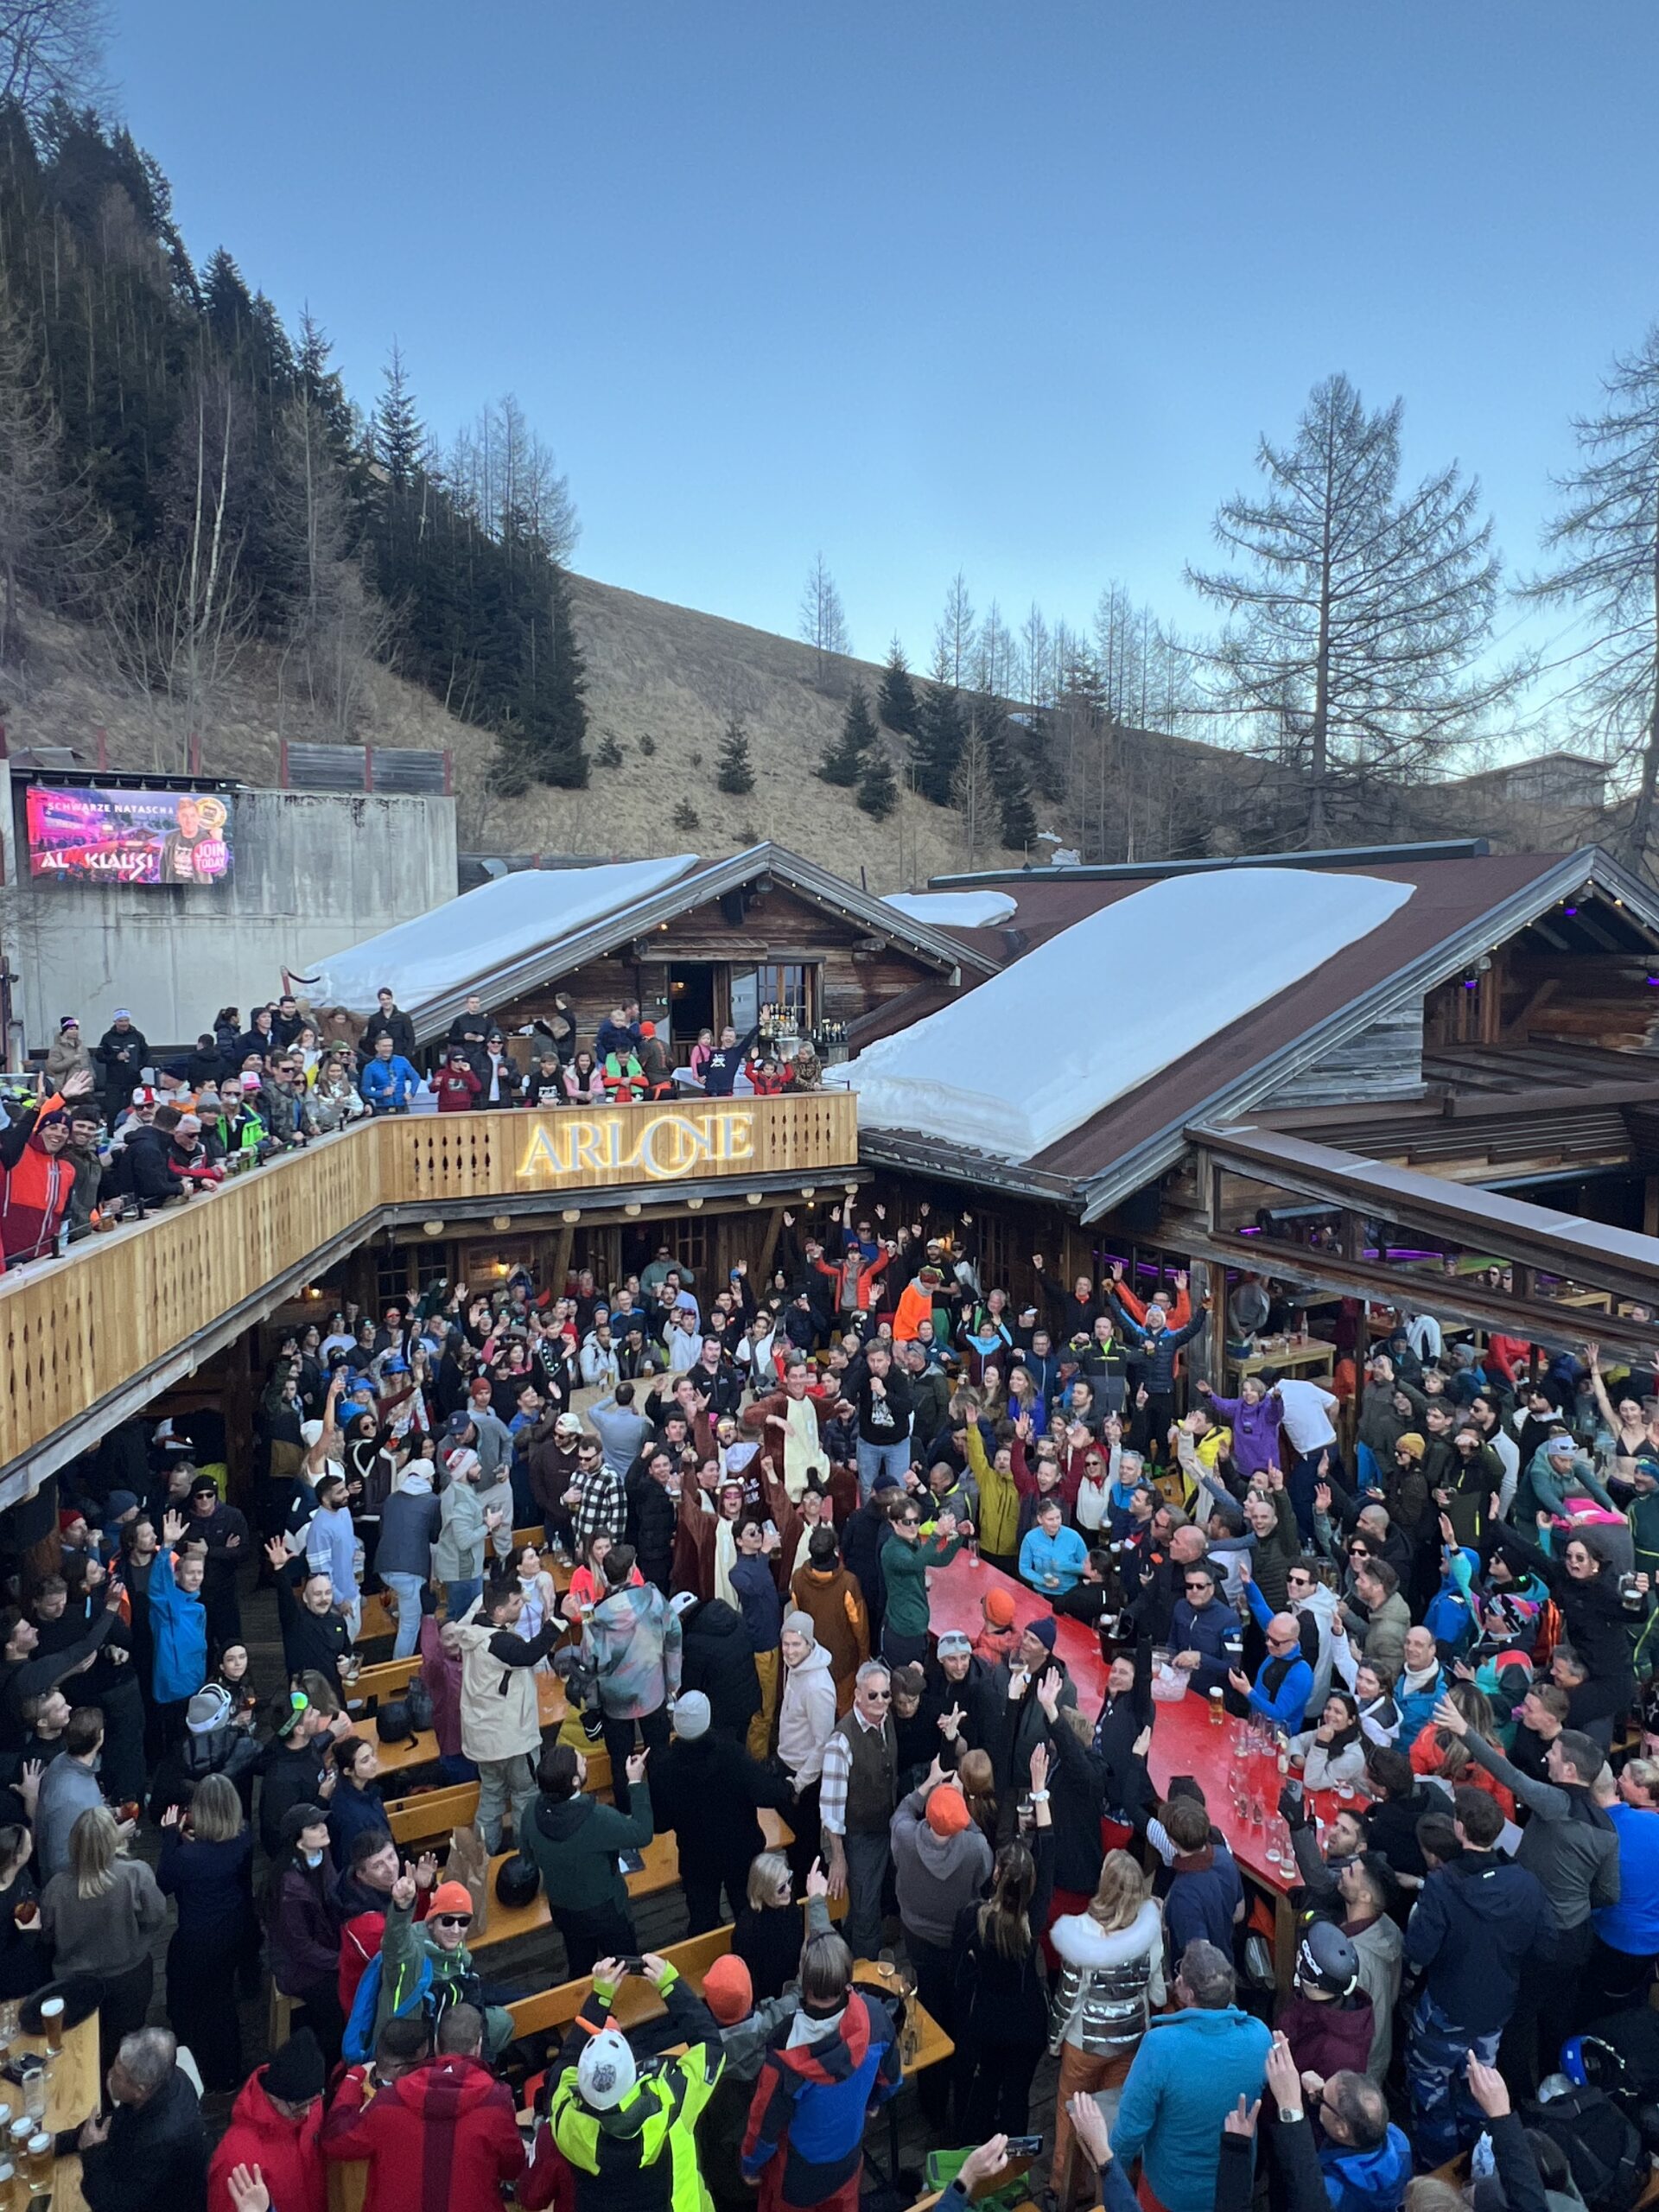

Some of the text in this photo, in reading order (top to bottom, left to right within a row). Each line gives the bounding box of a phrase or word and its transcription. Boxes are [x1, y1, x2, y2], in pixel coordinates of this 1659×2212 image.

[48, 801, 174, 815] SCHWARZE NATASCHA
[195, 841, 226, 858] JOIN
[196, 856, 226, 869] TODAY
